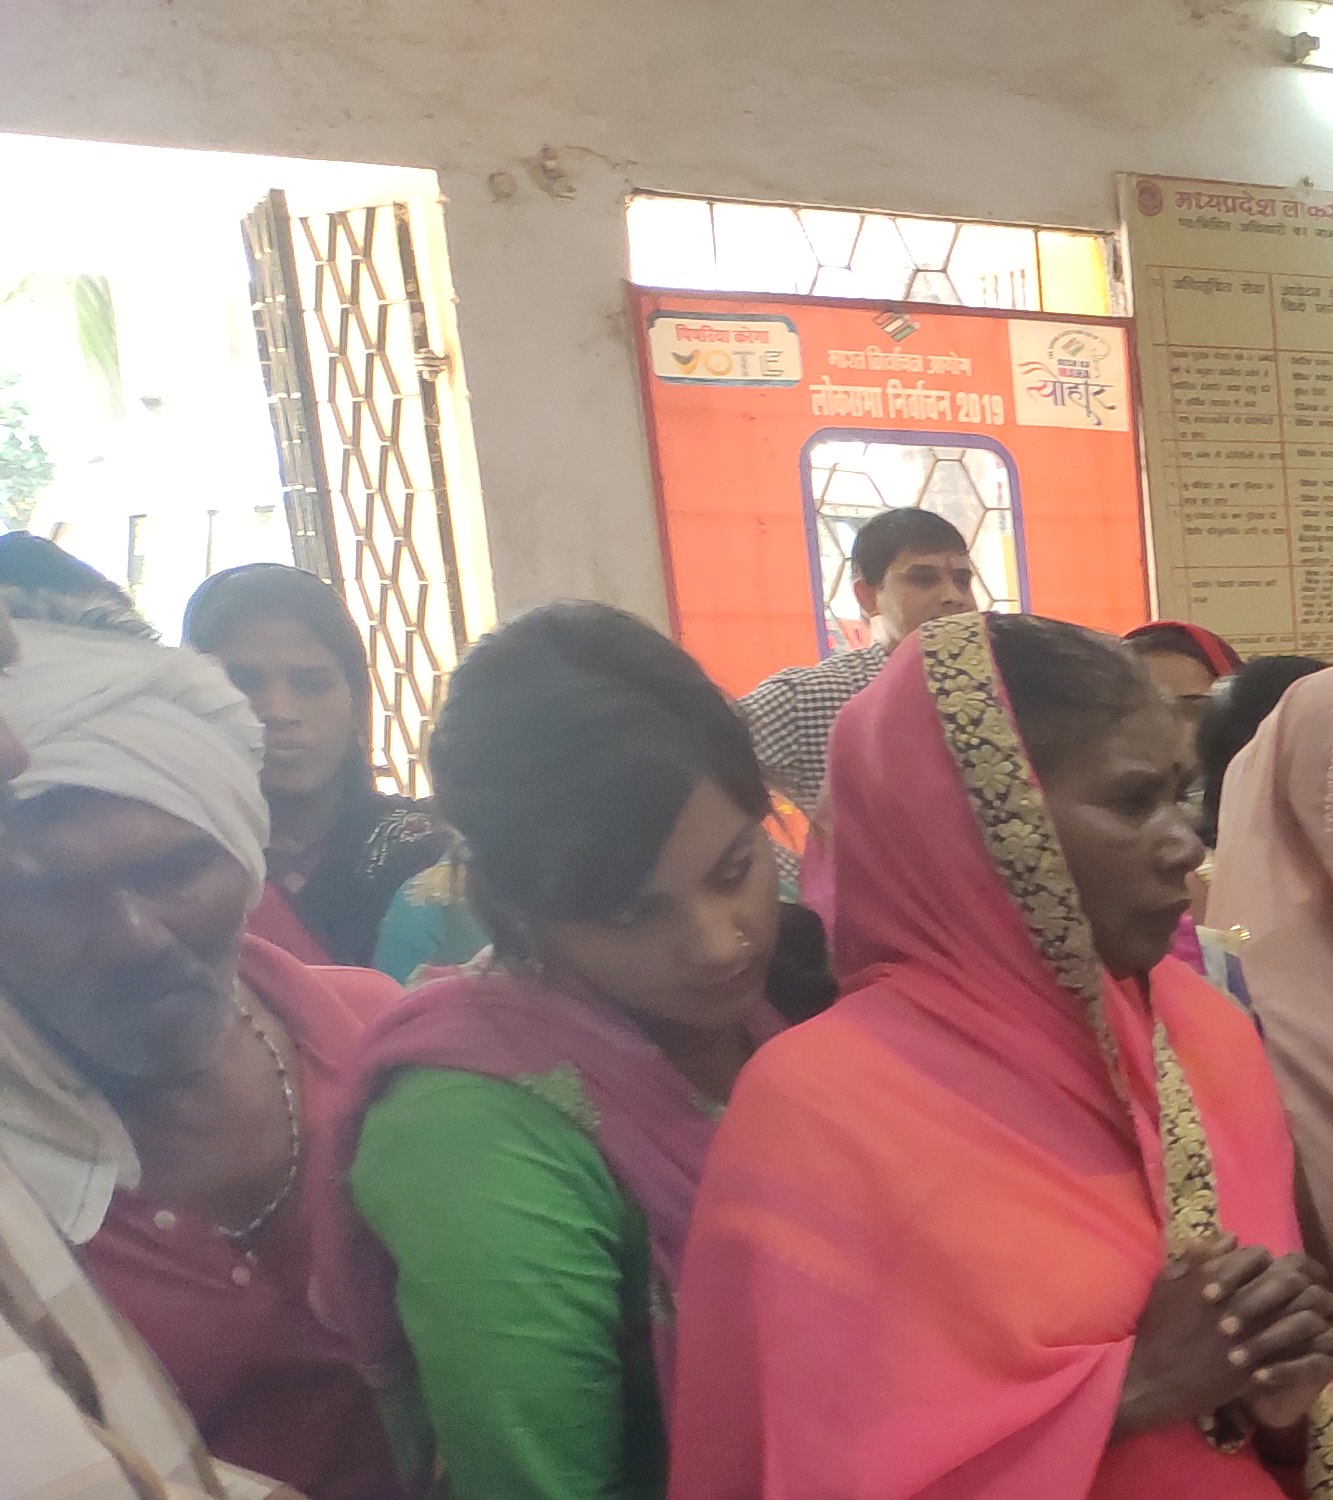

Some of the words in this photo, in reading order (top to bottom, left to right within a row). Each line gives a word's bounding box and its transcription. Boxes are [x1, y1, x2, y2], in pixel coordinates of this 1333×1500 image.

[1175, 191, 1276, 217] मध्यप्रदेश
[671, 349, 784, 377] VOTE
[828, 348, 867, 370] भारत
[926, 350, 973, 376] आयोग
[808, 374, 884, 419] लोकसभा
[886, 378, 952, 421] निर्वाचन
[955, 391, 1005, 426] 2019
